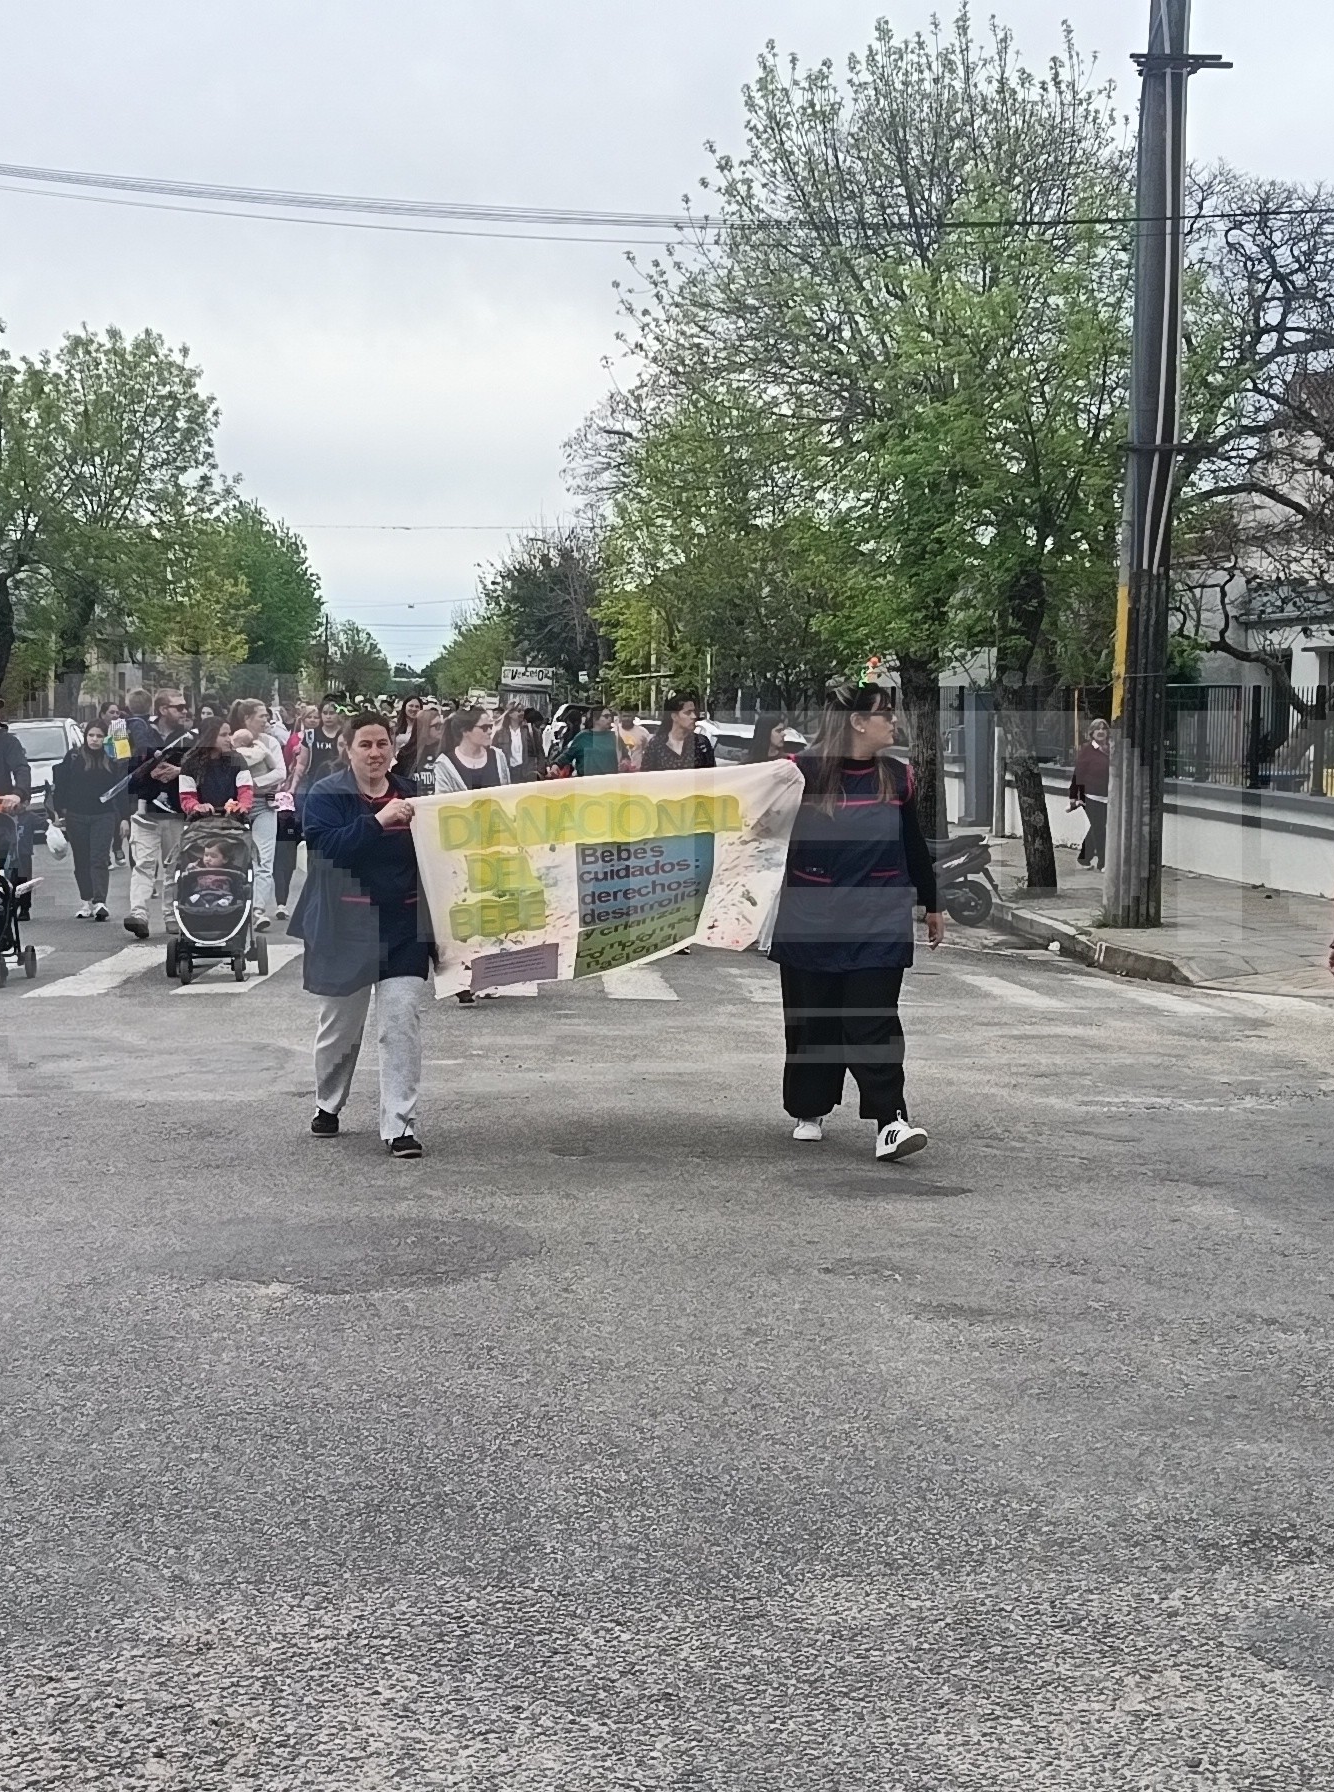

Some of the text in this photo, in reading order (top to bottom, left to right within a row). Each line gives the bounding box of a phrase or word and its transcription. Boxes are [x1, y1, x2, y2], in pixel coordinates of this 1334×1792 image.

[520, 796, 742, 845] NACIONAL
[580, 842, 665, 866] Bebés
[468, 856, 540, 893] DEL
[581, 877, 702, 906] derechos,
[582, 888, 700, 926] desarrollo
[582, 927, 596, 942] y
